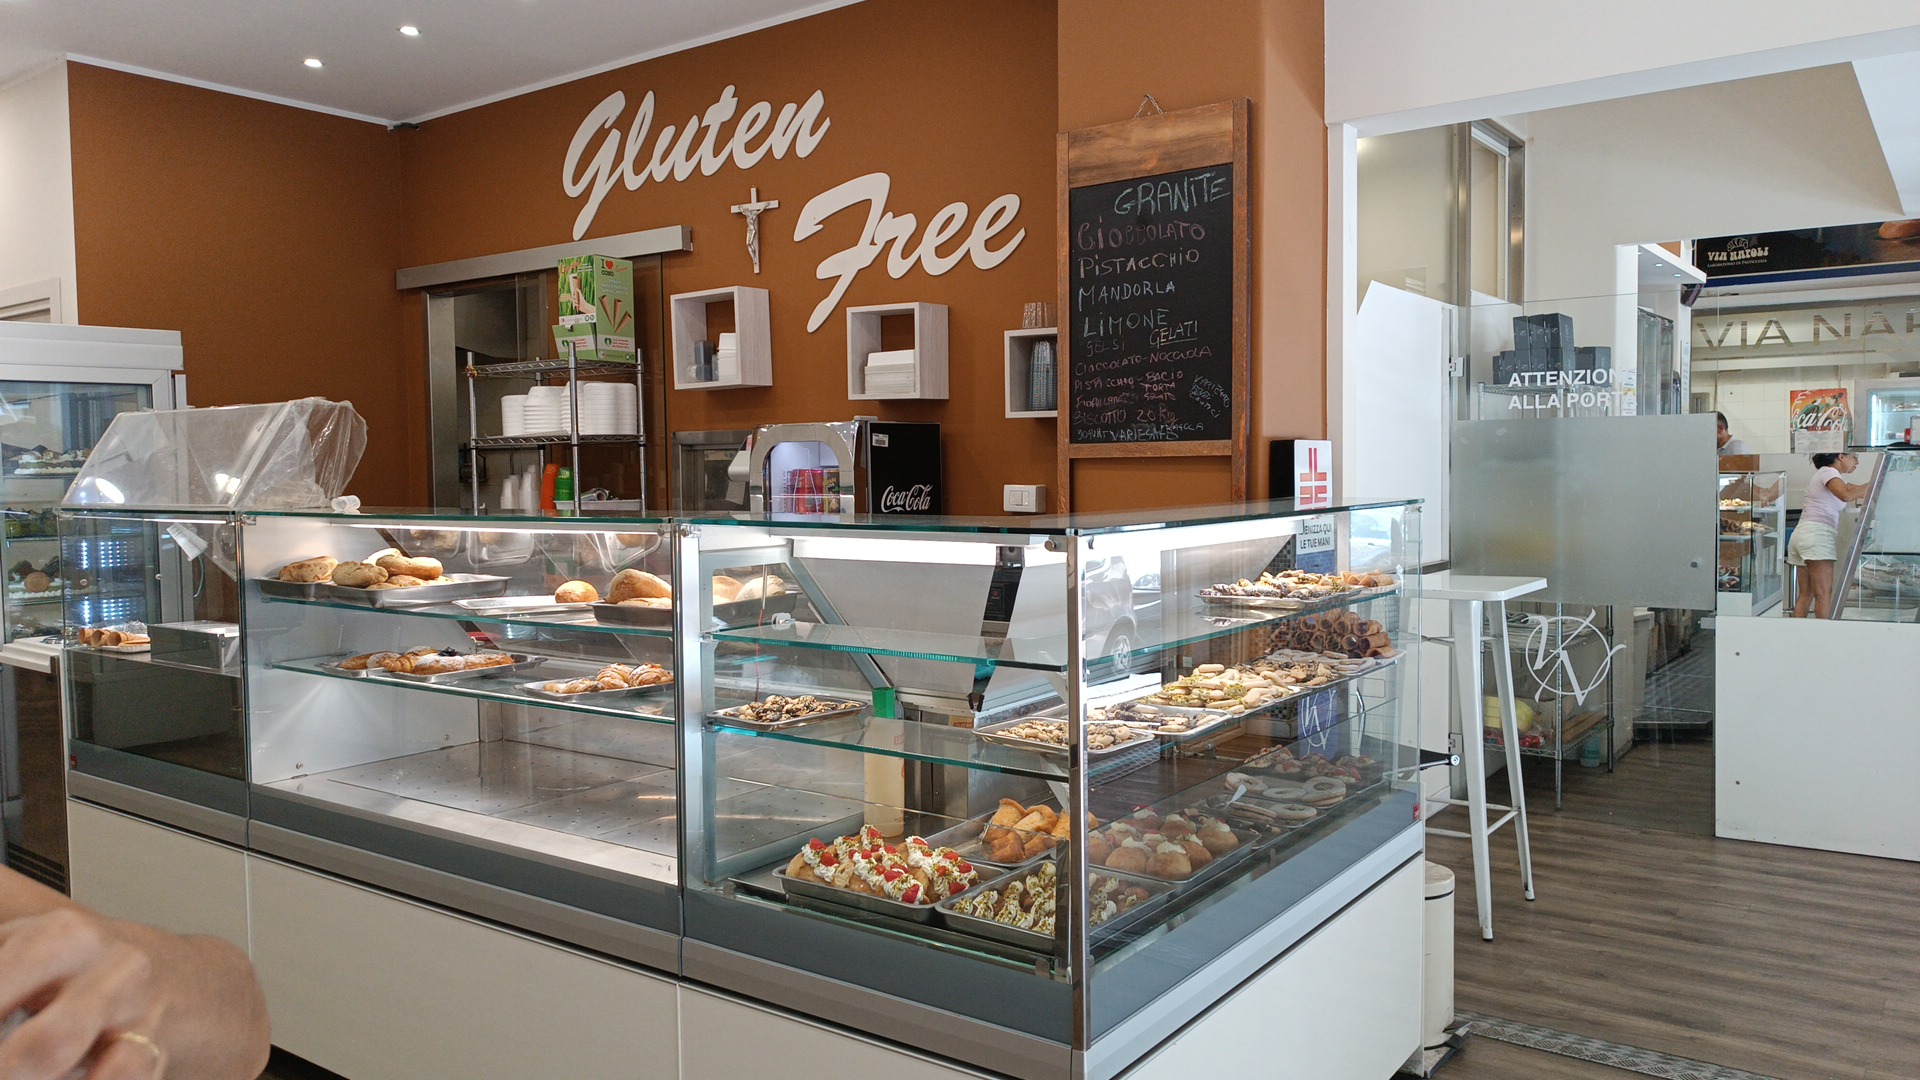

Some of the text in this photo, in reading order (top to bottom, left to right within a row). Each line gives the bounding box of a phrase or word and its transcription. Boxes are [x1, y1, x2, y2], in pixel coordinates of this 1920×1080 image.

[562, 84, 831, 242] Gluten
[793, 172, 1026, 333] Free
[1707, 246, 1769, 261] VIA NAPOLI
[1078, 280, 1175, 312] MANDORLA
[1149, 320, 1198, 349] GELATI
[1695, 317, 1794, 351] VIA
[1508, 393, 1561, 410] ALLA
[880, 484, 933, 513] Coca-Cola
[1300, 536, 1331, 550] LE TUE MANI
[1323, 523, 1332, 536] QUI
